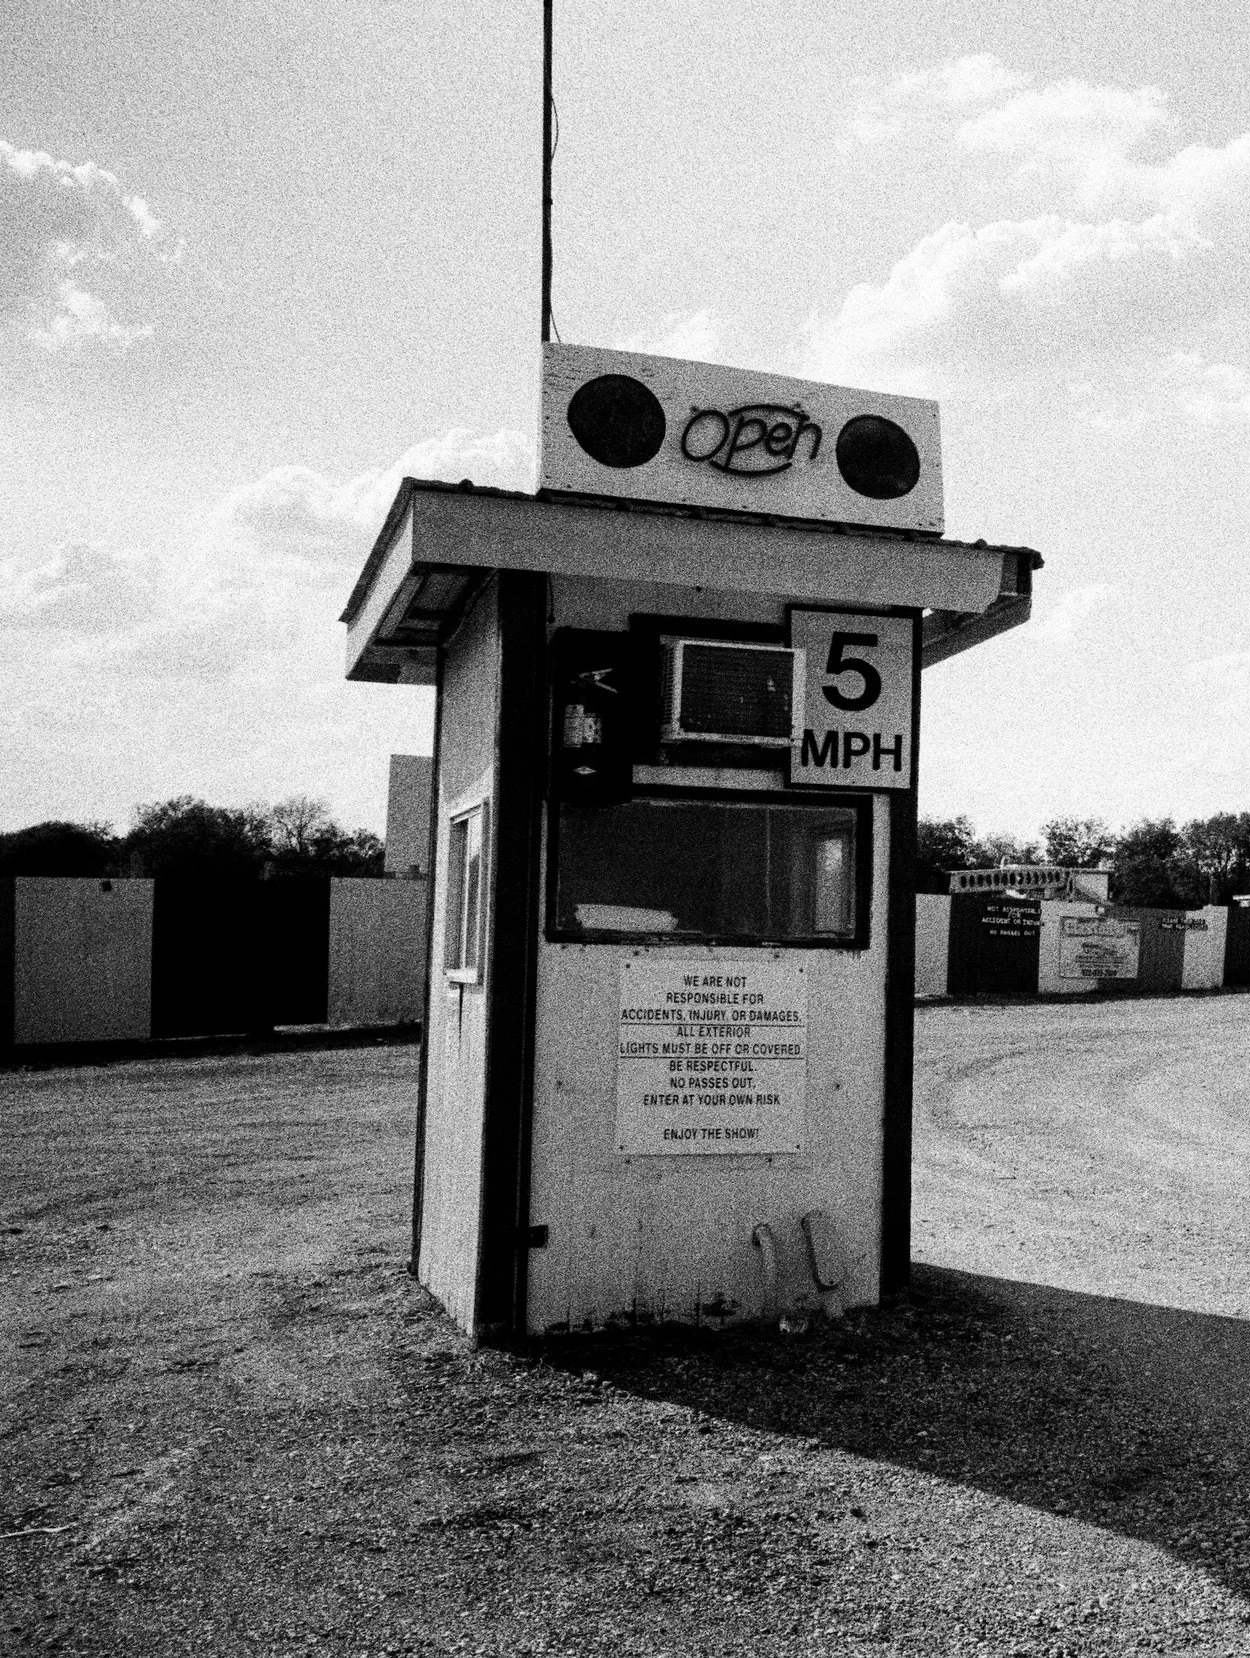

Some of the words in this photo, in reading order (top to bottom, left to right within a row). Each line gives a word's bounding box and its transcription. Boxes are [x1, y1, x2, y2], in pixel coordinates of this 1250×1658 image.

[681, 408, 822, 468] Open
[821, 631, 882, 712] 5
[801, 729, 903, 772] MPH
[683, 975, 699, 987] WE
[702, 976, 723, 988] ARE
[726, 976, 747, 988] NOT
[666, 992, 739, 1004] RESPONSIBLE
[743, 993, 764, 1005] FOR
[731, 1010, 746, 1021] OR
[677, 1026, 695, 1037] ALL
[699, 1026, 751, 1038] EXTERIOR
[620, 1042, 659, 1054] LIGHTS
[662, 1042, 691, 1054] MUST
[694, 1043, 708, 1055] BE
[711, 1043, 732, 1055] OFF
[735, 1043, 750, 1055] OR
[752, 1043, 801, 1056] COVERED
[669, 1060, 683, 1072] BE
[670, 1077, 686, 1088] NO
[688, 1077, 729, 1089] PASSES
[643, 1094, 679, 1106] ENTER
[682, 1094, 695, 1106] AT
[698, 1094, 726, 1106] YOUR
[728, 1094, 753, 1106] OWN
[663, 1128, 698, 1140] ENJOY
[700, 1128, 722, 1140] THE
